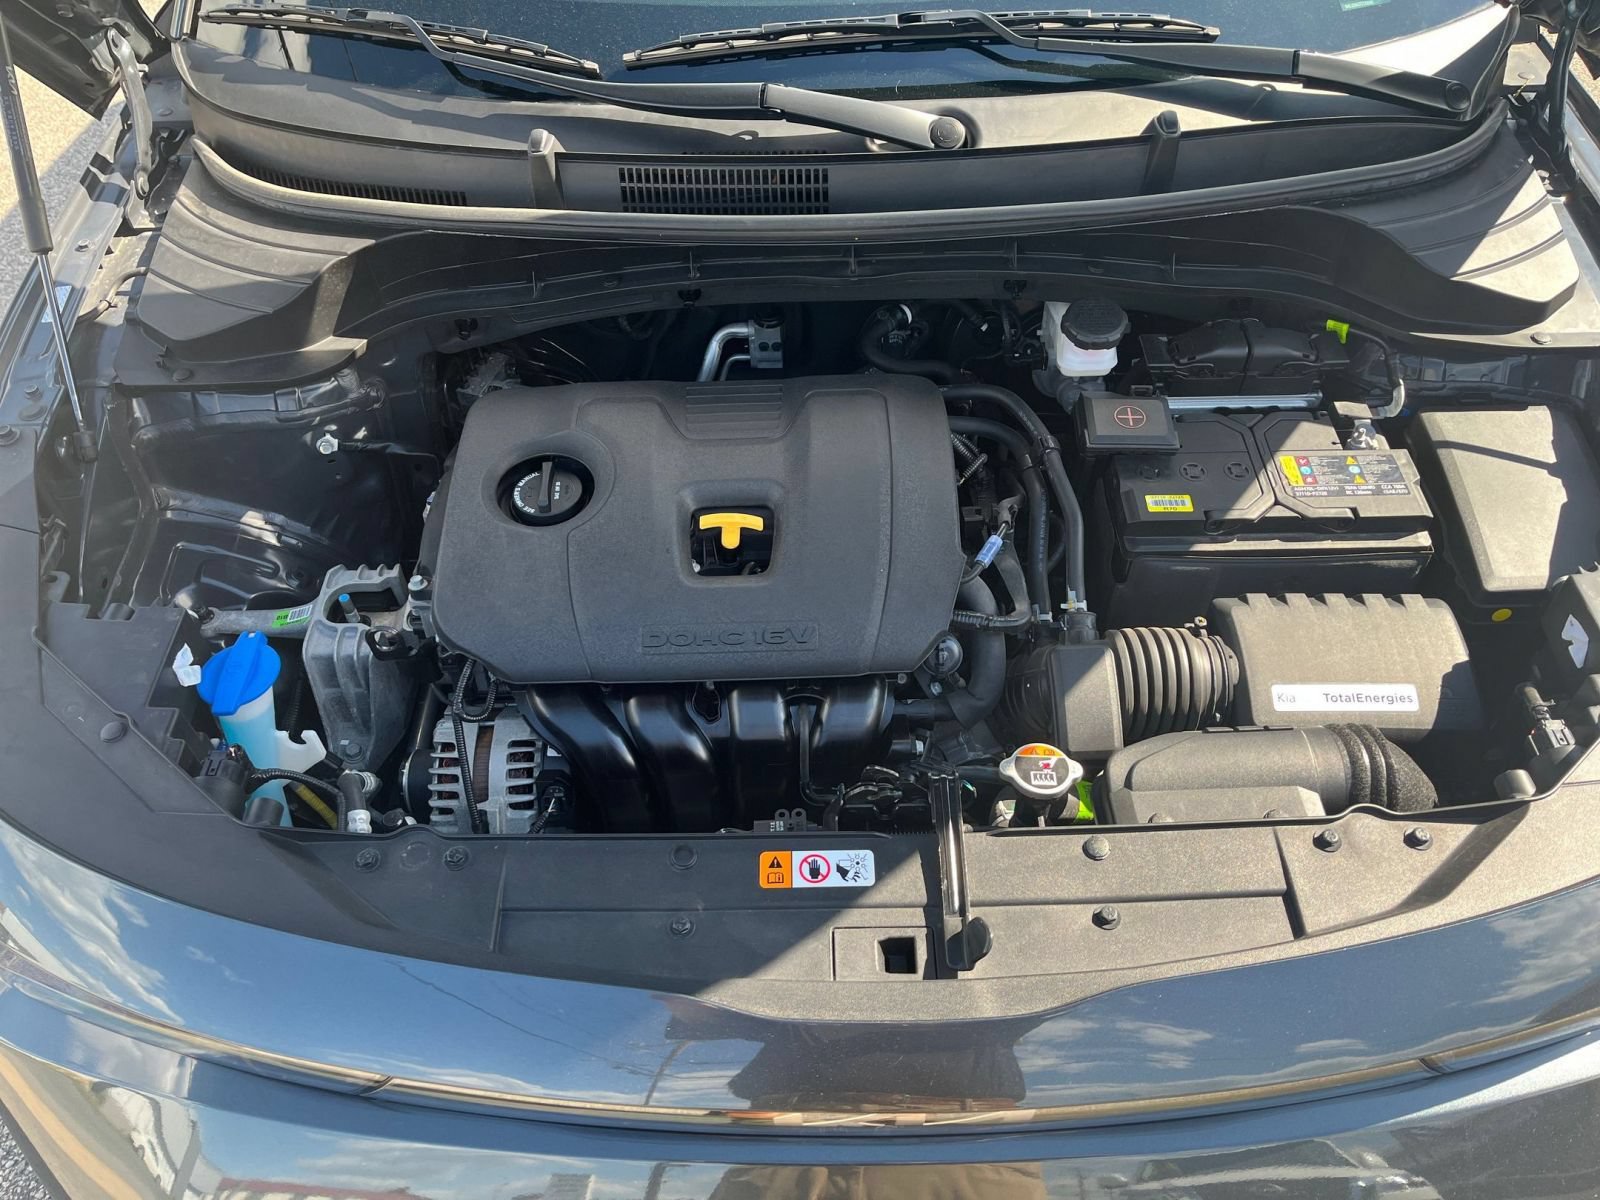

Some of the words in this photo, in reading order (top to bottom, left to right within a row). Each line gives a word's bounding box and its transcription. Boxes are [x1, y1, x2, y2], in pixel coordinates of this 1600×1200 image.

[642, 629, 746, 648] DOHC
[755, 627, 814, 645] 16V
[1277, 692, 1296, 703] Kia
[1323, 692, 1414, 705] TotalEnergies
